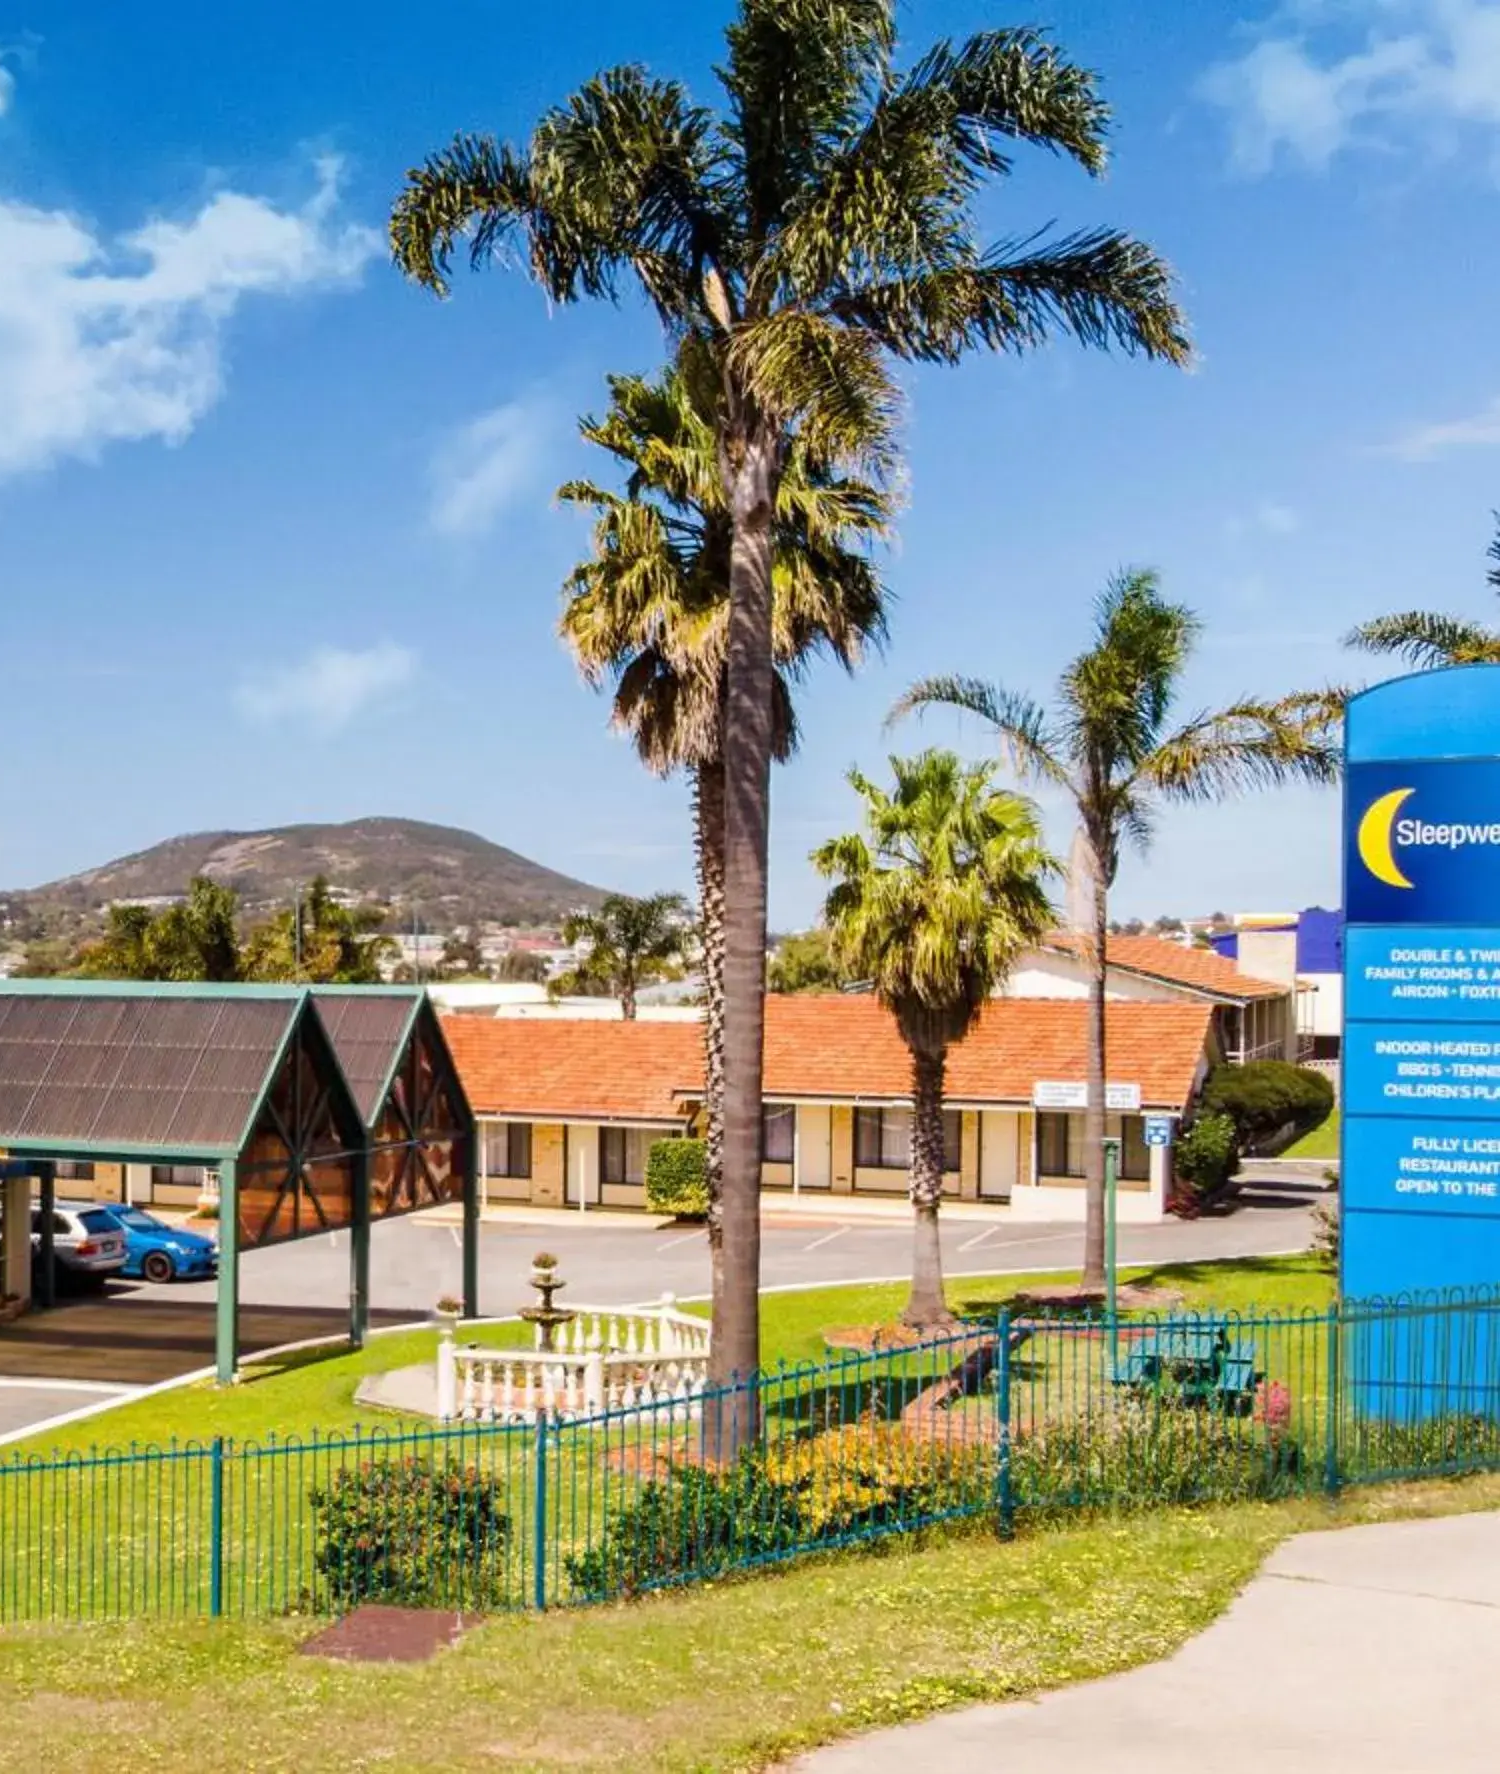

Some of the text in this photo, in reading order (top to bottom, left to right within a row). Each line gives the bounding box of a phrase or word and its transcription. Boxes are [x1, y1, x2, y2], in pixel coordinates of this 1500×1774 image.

[1390, 948, 1452, 962] DOUBLE
[1454, 949, 1466, 961] &
[1364, 966, 1418, 980] FAMILY
[1419, 967, 1473, 980] ROOMS
[1476, 967, 1489, 980] &
[1392, 984, 1449, 998] AIRCON
[1375, 1041, 1432, 1055] INDOOR
[1432, 1041, 1491, 1057] HEATED
[1412, 1136, 1460, 1152] FULLY
[1399, 1157, 1500, 1175] RESTAURANT
[1395, 1179, 1497, 1197] OPEN TO THE
